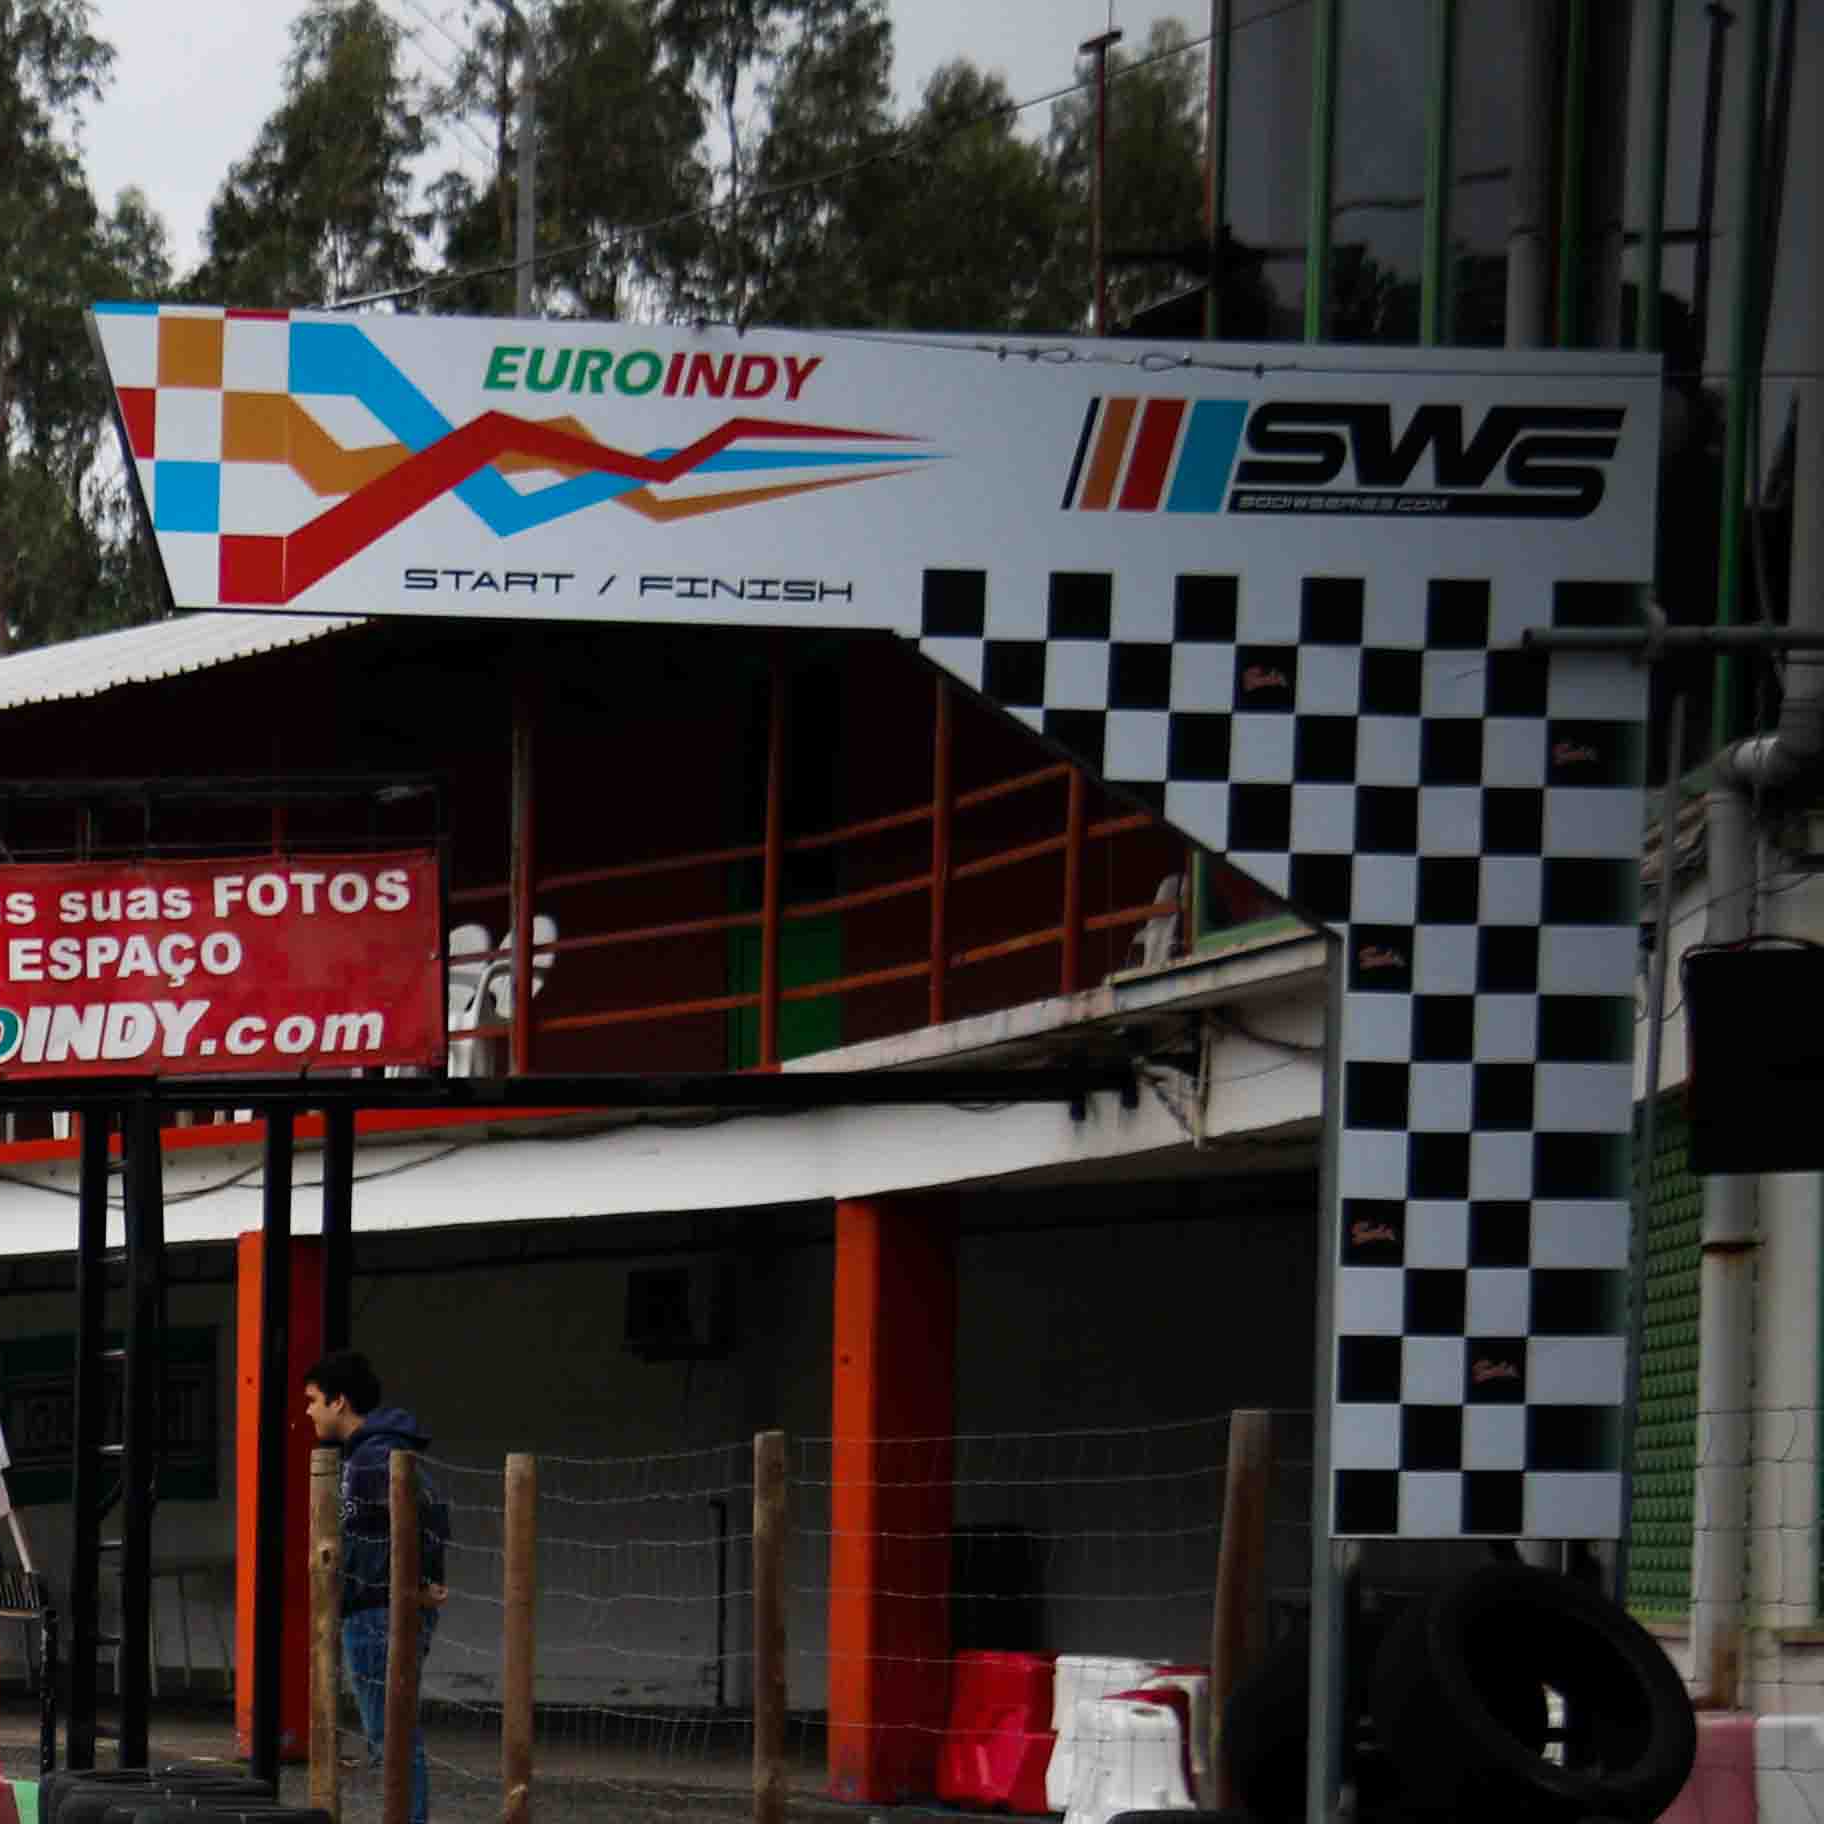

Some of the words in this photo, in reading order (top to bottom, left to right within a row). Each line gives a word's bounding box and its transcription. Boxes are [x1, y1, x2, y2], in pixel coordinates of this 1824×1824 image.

[482, 345, 823, 401] EUROINDY
[1230, 401, 1628, 520] SWS
[403, 568, 575, 594] START
[638, 575, 853, 603] FINISH
[58, 887, 192, 923] suas
[212, 869, 411, 918] FOTOS
[7, 931, 242, 988] ESPAÇO
